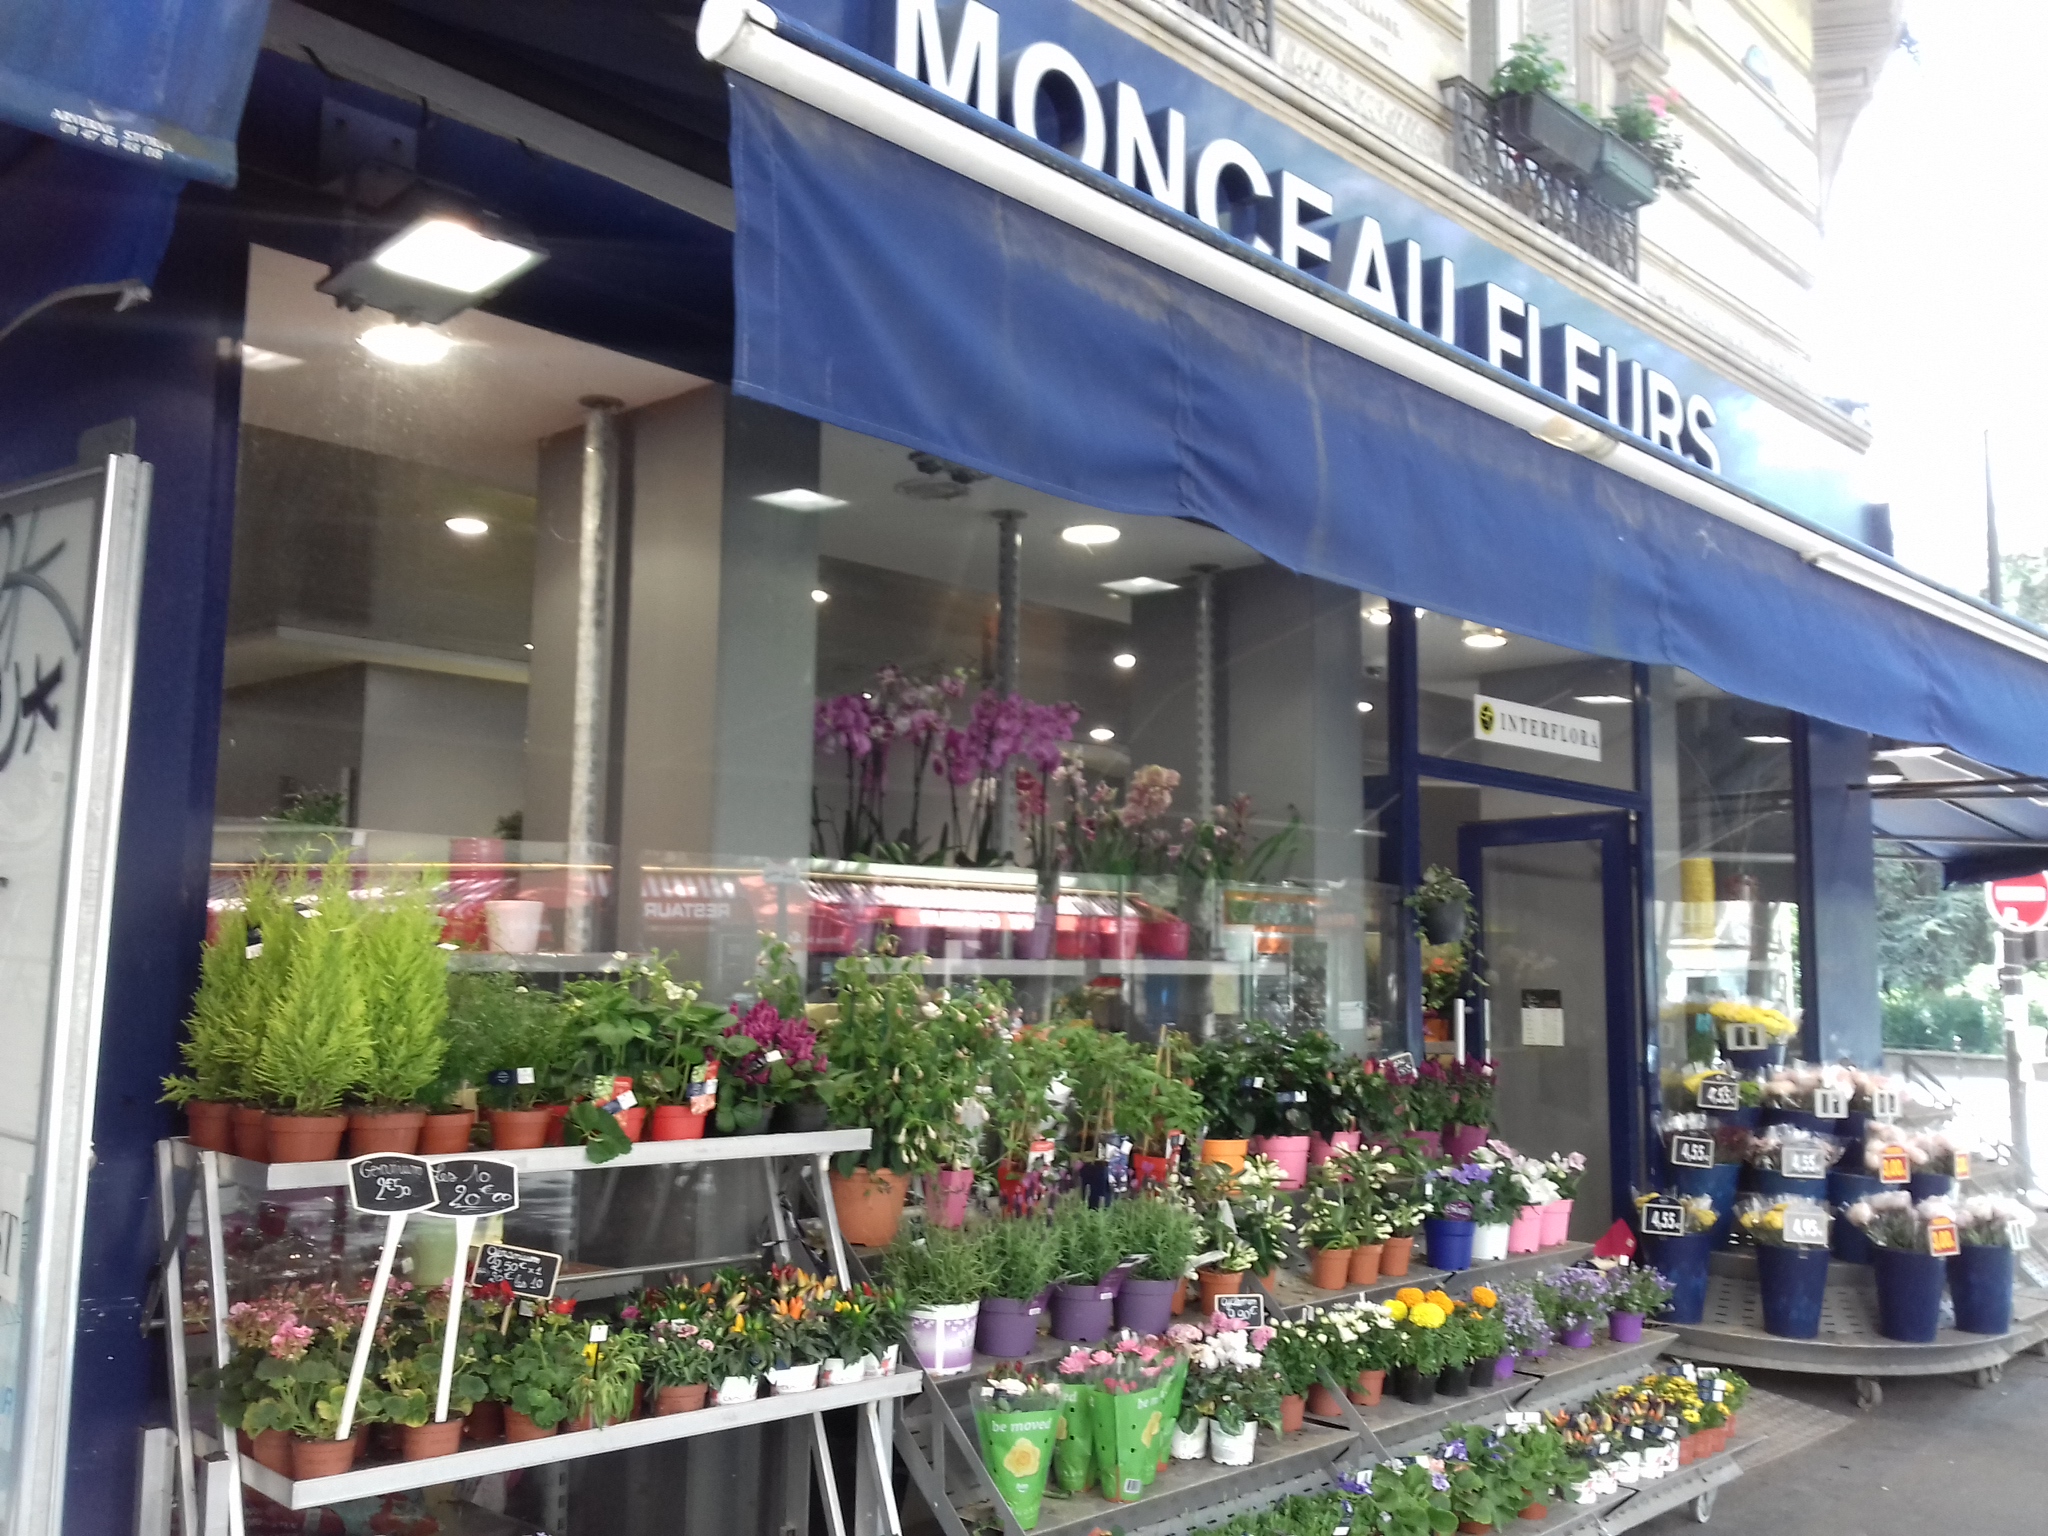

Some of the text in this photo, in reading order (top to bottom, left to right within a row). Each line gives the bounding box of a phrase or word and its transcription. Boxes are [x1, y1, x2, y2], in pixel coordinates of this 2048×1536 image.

[895, 0, 1721, 475] MONCEAU FLEURS
[1500, 712, 1600, 749] INTERFLORA
[463, 1163, 492, 1183] 10
[991, 1417, 1052, 1433] be moved
